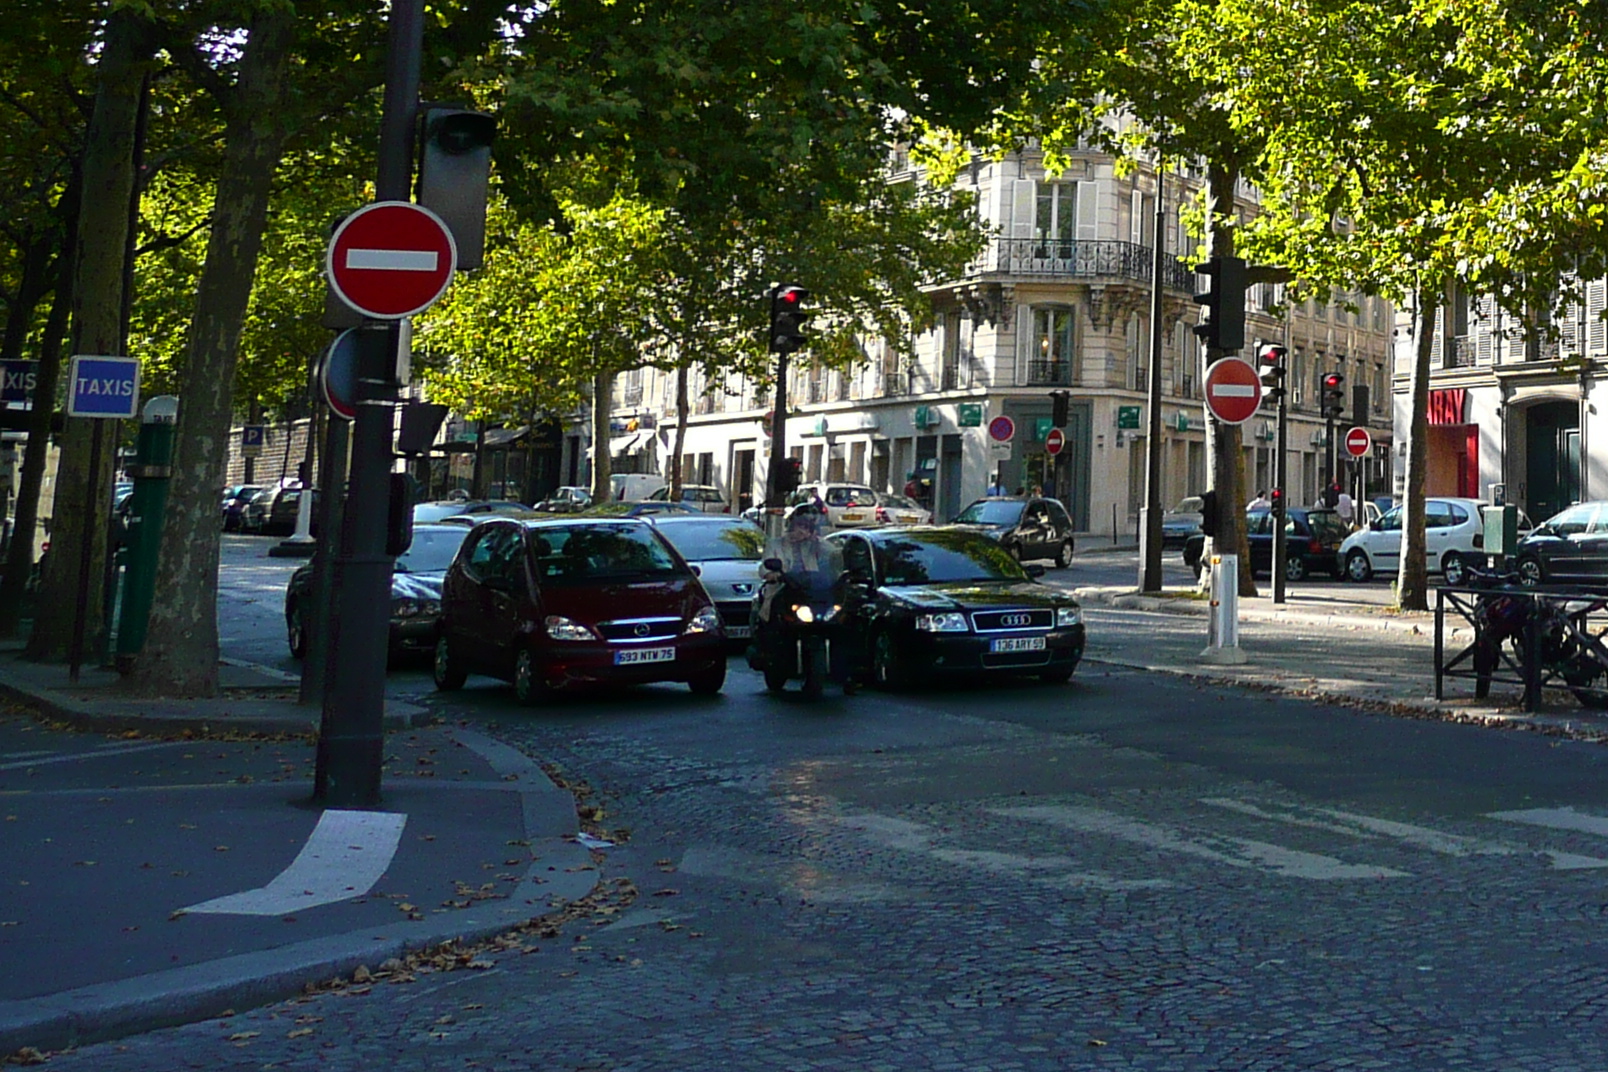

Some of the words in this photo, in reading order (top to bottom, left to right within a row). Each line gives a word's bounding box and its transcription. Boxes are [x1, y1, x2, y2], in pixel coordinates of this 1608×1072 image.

[79, 378, 133, 396] TAXIS
[248, 430, 258, 442] P
[661, 648, 673, 659] 75
